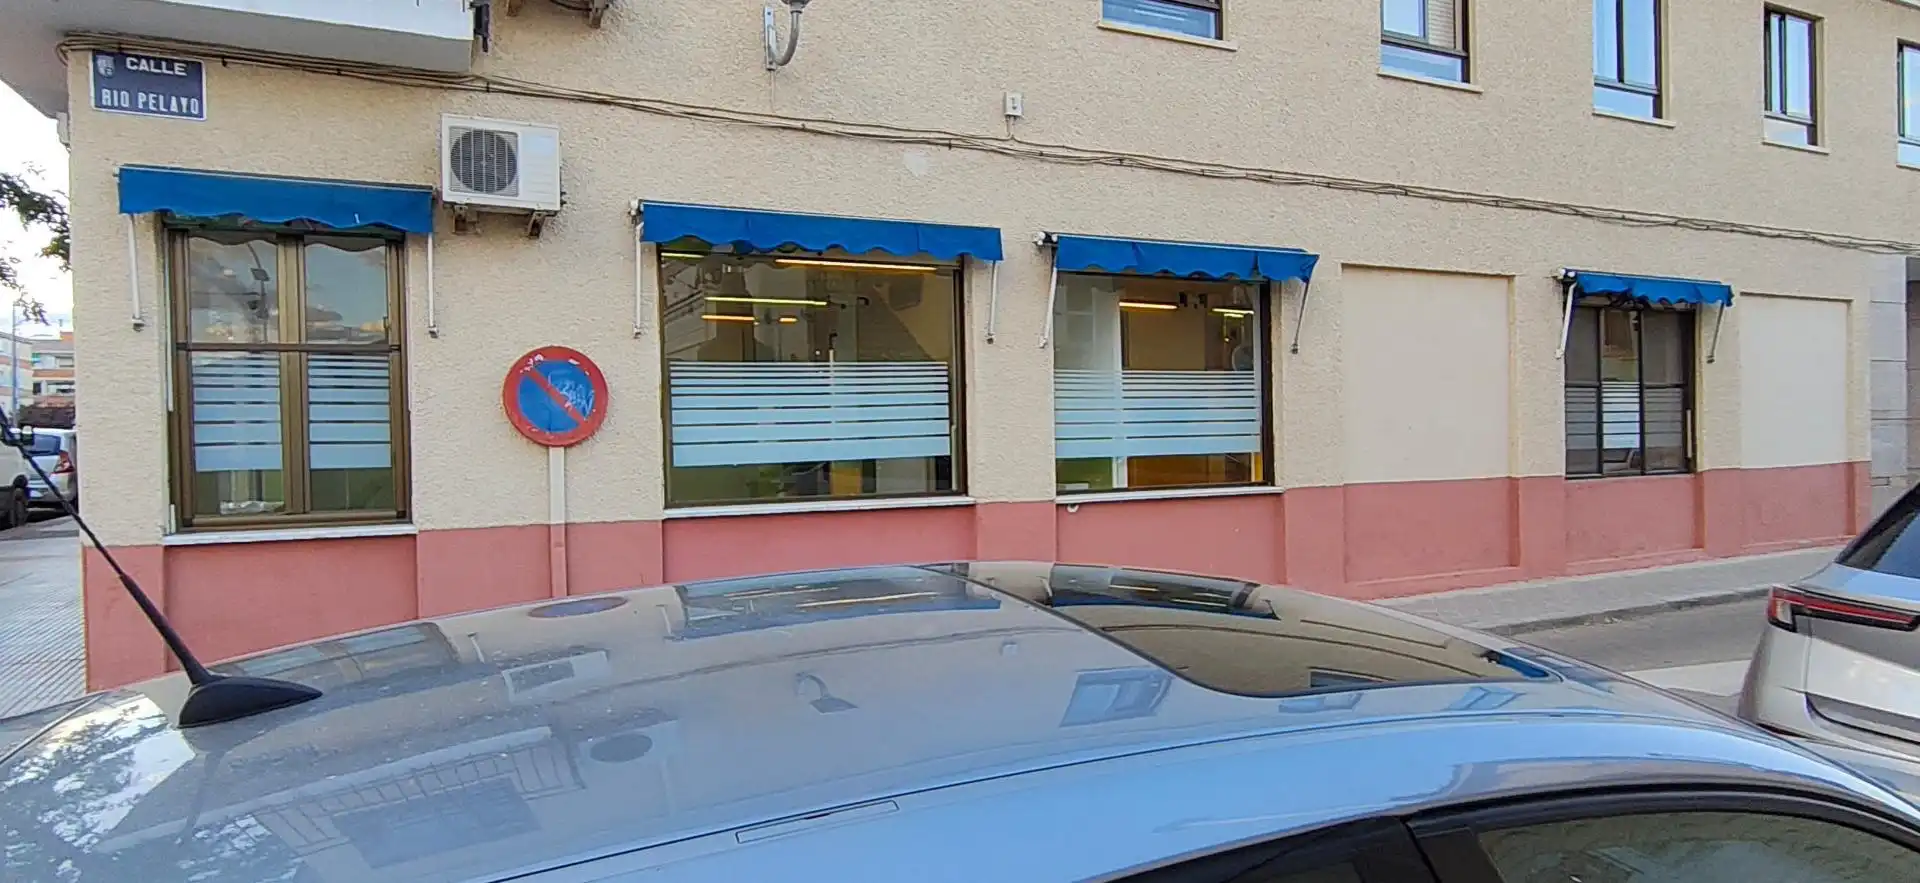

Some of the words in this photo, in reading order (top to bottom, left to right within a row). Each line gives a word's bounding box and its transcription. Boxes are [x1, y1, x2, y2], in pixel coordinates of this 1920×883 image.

[125, 56, 187, 76] CALLE
[101, 88, 130, 108] RIO
[137, 92, 199, 115] PELAYO
